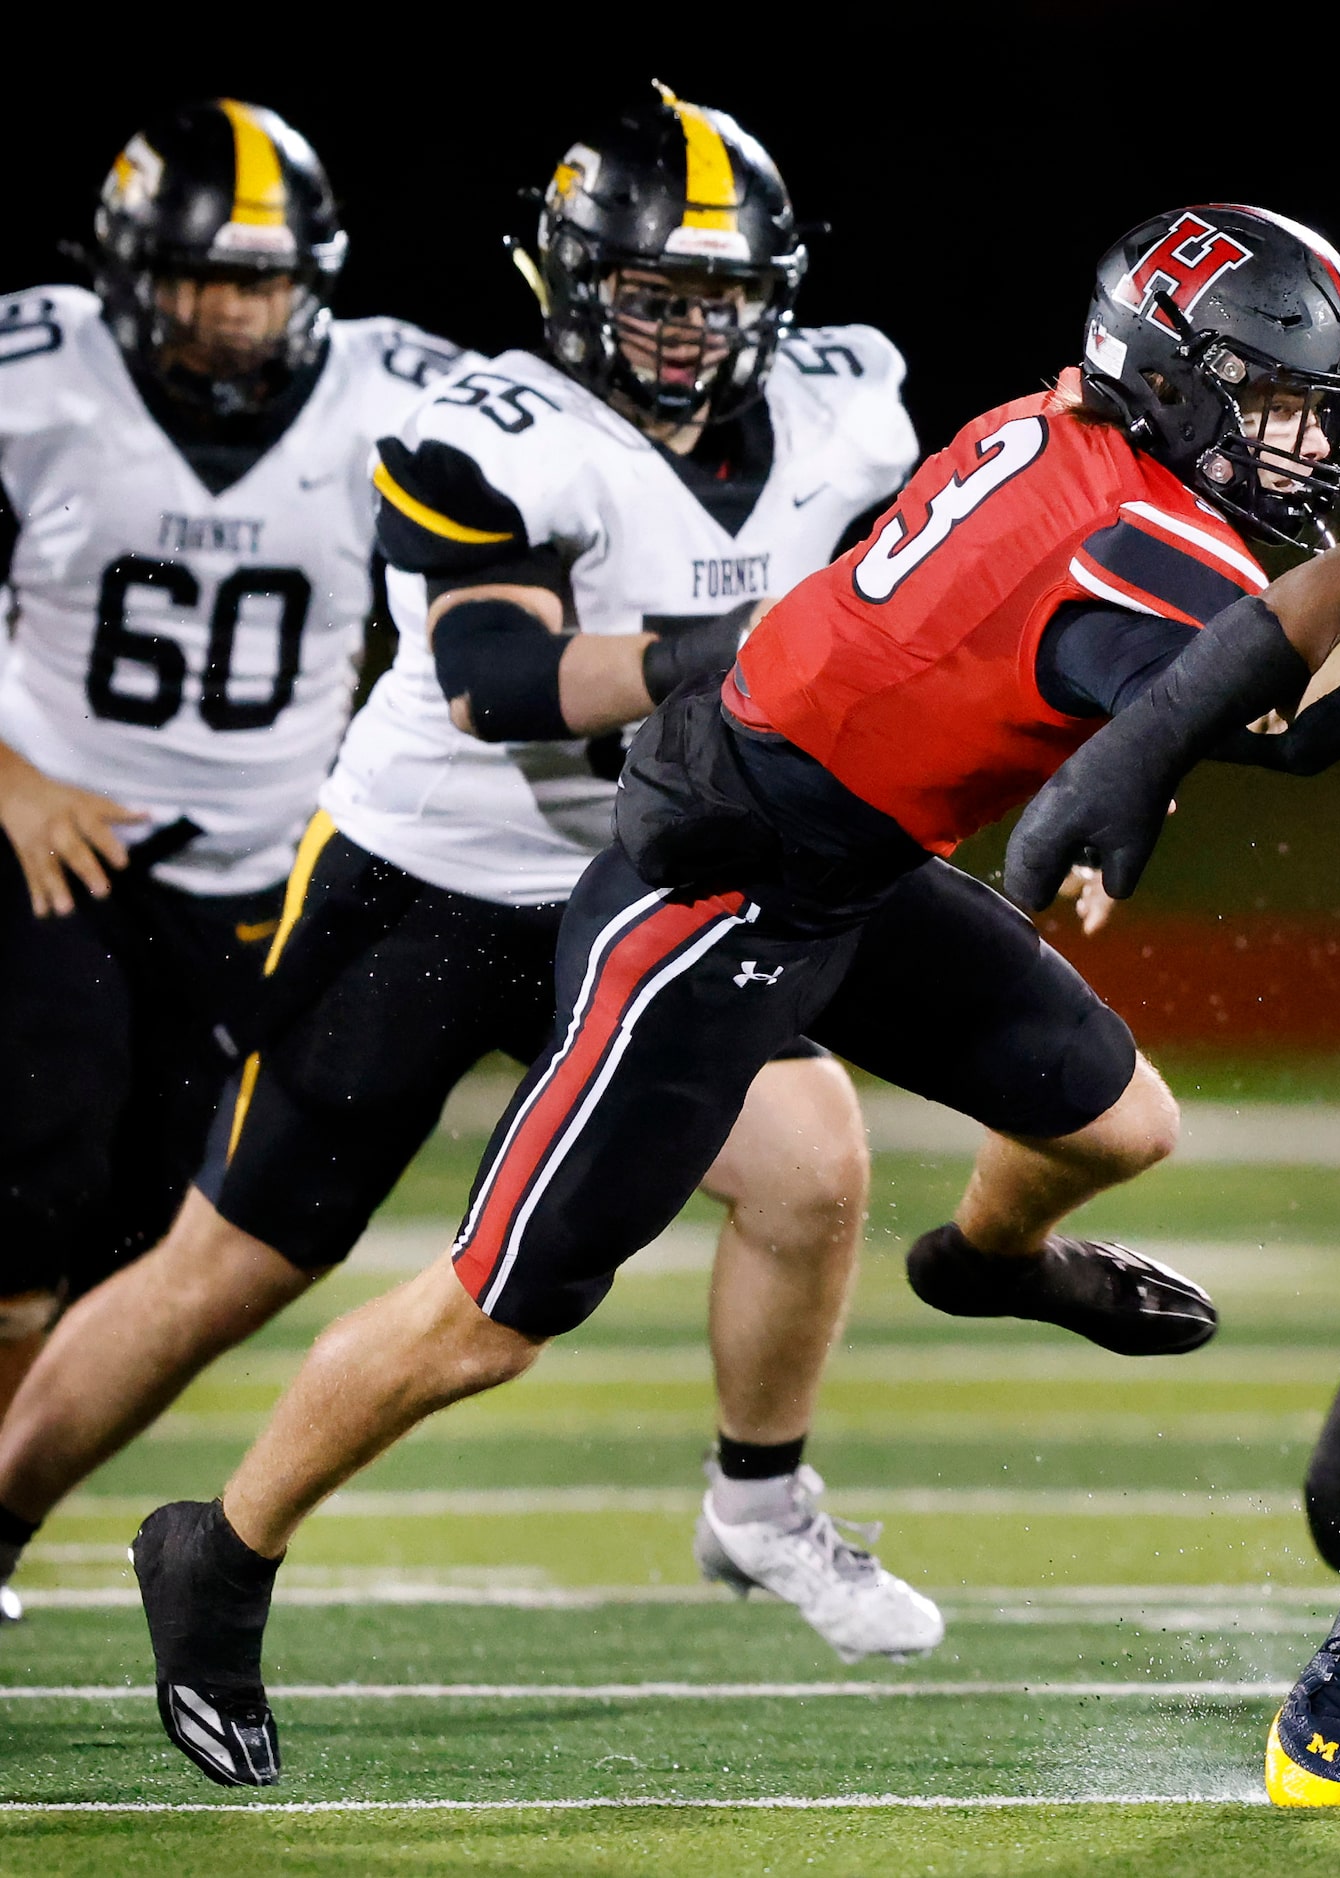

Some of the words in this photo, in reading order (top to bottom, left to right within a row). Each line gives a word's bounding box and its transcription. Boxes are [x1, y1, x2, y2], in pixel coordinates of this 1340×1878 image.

[1112, 211, 1254, 341] H
[433, 373, 562, 434] 55
[852, 414, 1050, 605] 3
[692, 552, 770, 598] FORNEY
[85, 555, 312, 732] 60
[1306, 1732, 1340, 1763] M
